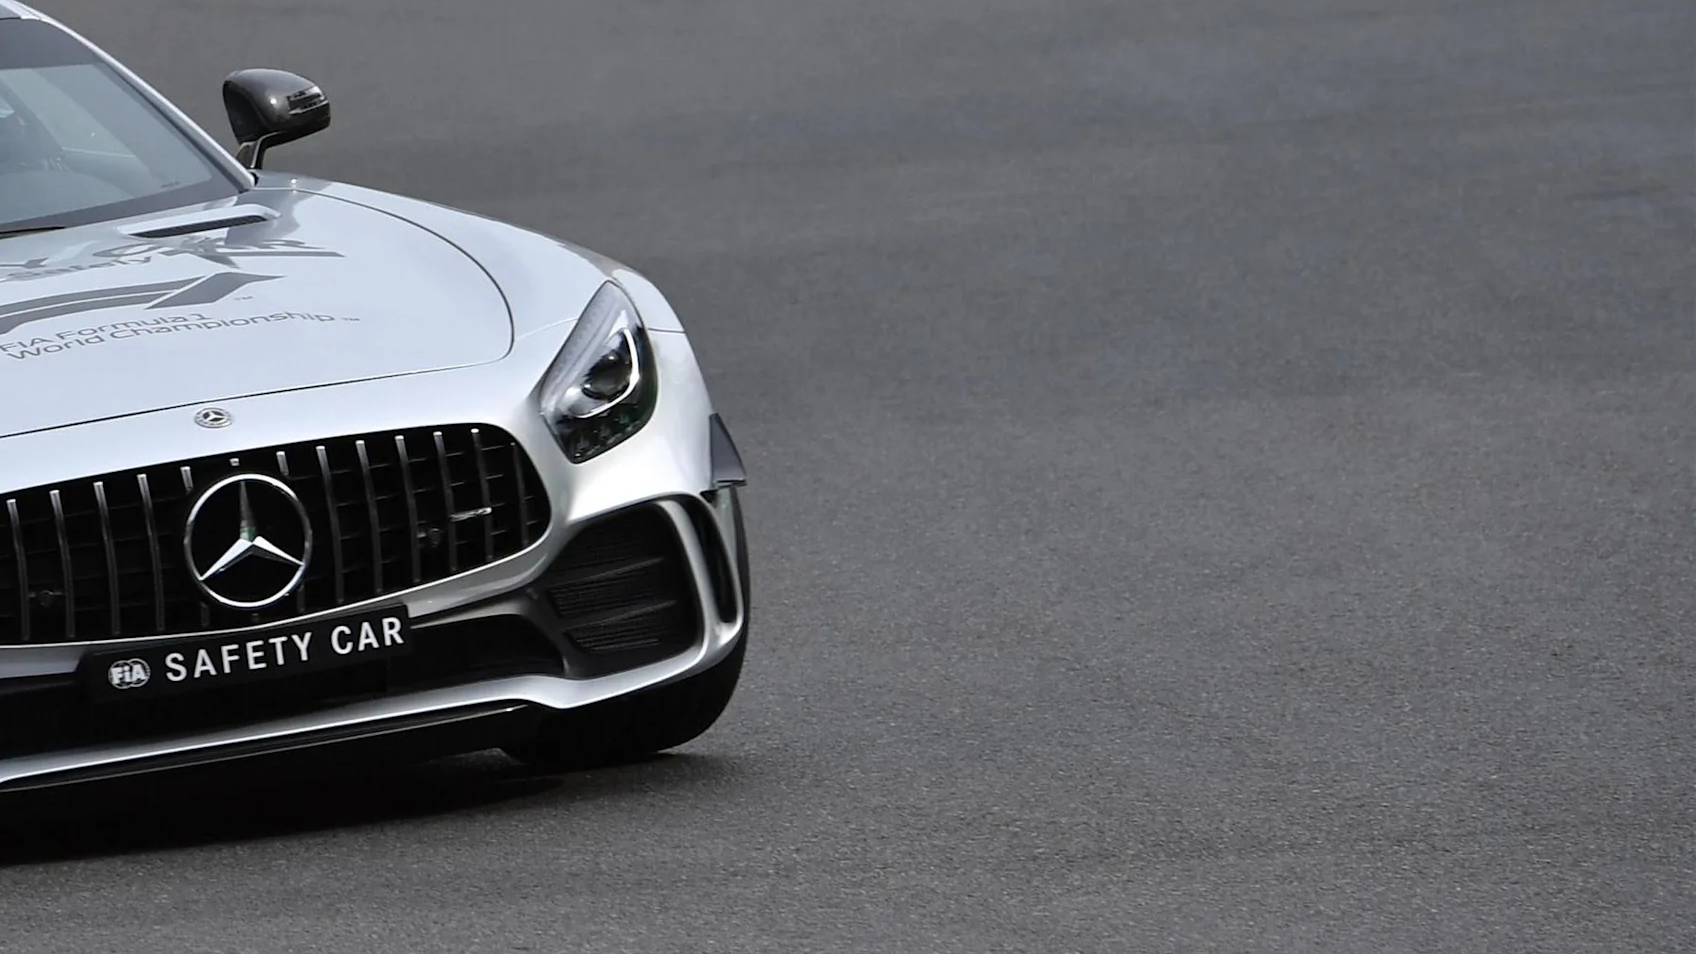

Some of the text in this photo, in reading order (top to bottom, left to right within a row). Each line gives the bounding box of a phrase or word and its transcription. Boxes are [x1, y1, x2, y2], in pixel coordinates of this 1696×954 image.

[7, 333, 105, 360] World
[109, 311, 335, 339] Championship
[56, 314, 189, 341] Formula
[165, 632, 313, 682] SAFETY
[331, 617, 404, 655] CAR
